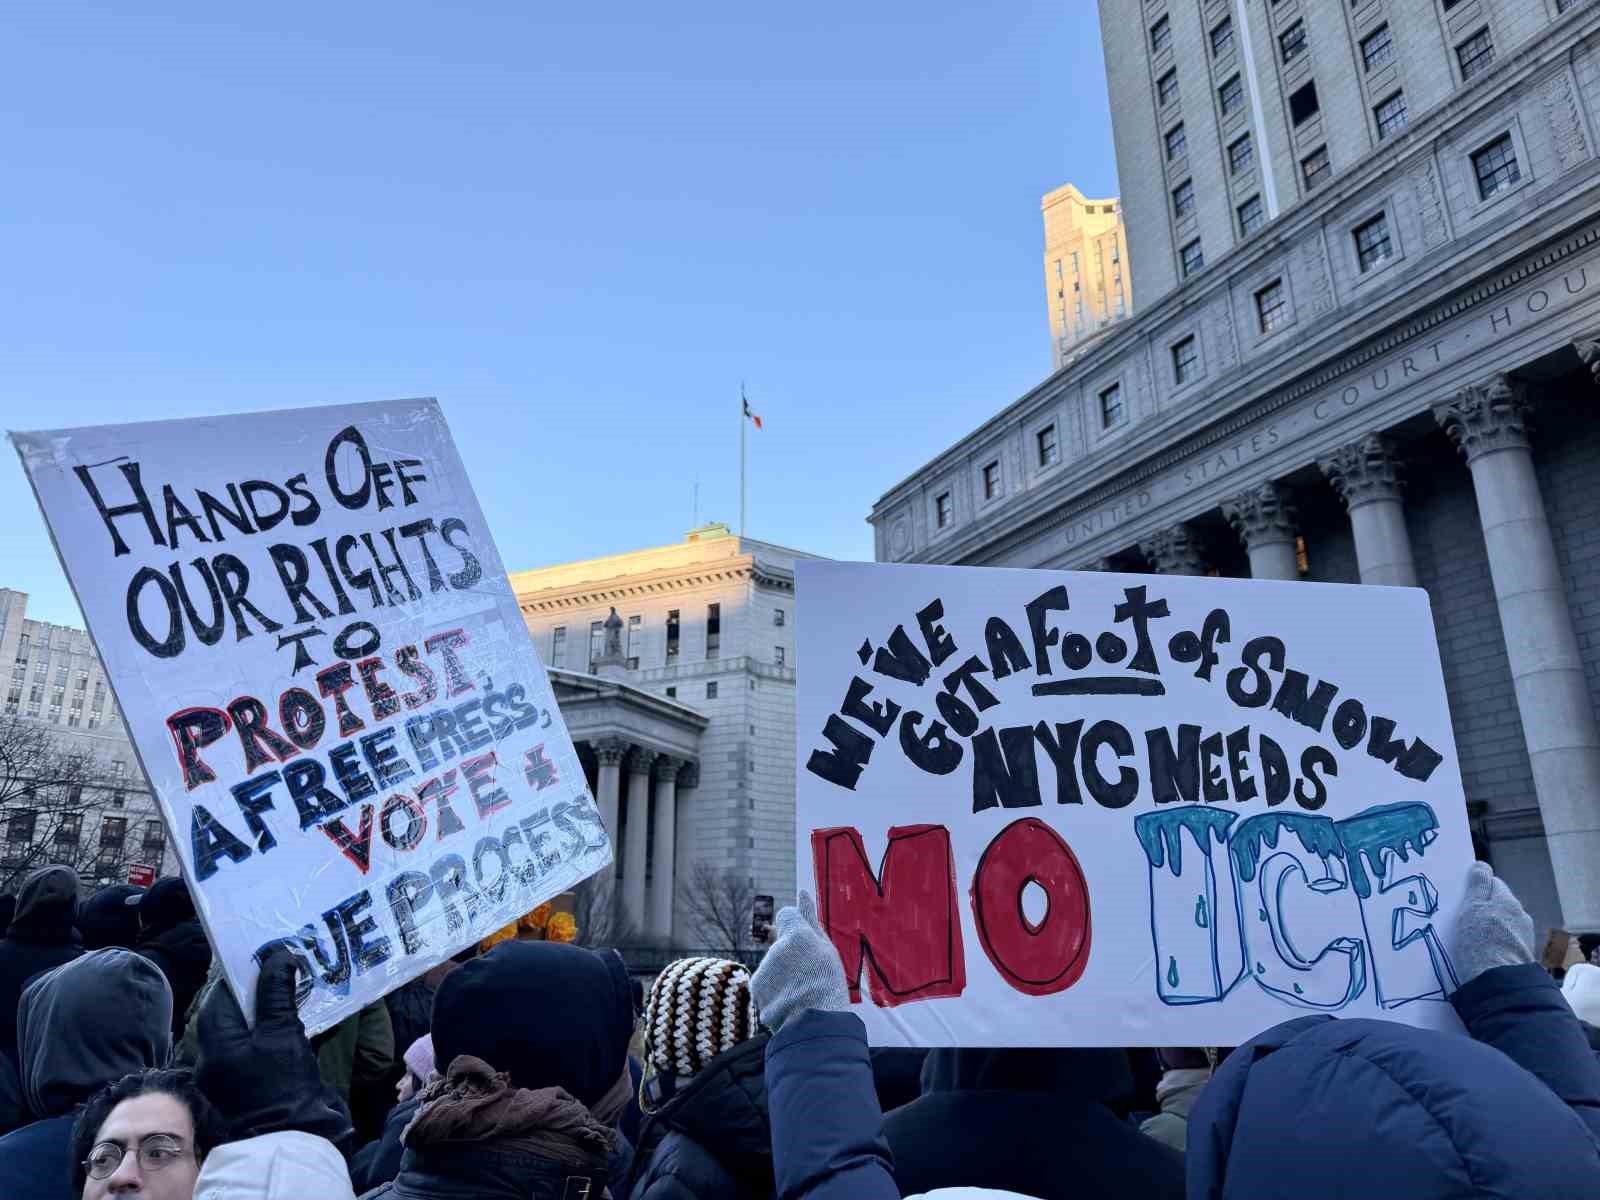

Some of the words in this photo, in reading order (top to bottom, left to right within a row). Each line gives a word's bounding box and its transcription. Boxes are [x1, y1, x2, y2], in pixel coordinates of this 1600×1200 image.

[1064, 491, 1151, 545] UNITED
[1183, 425, 1280, 487] STATES
[1313, 340, 1444, 420] COURT
[1489, 267, 1587, 334] HOU
[74, 456, 321, 557] HANDS
[325, 425, 427, 512] OFF
[126, 553, 283, 658] OUR
[268, 518, 483, 627] RIGHTS
[277, 620, 382, 677] TO
[806, 597, 959, 790] WE'VE
[899, 655, 1001, 775] GOT
[984, 615, 1032, 680] A
[1167, 607, 1231, 681] of
[1225, 635, 1444, 783] SNOW
[192, 803, 252, 882] A
[230, 726, 415, 854] FREE
[404, 682, 553, 776] PRESS,
[317, 751, 512, 874] VOTE
[971, 718, 1140, 814] NYC
[1144, 722, 1339, 810] NEEDS
[811, 816, 1092, 1008] NO
[1134, 801, 1460, 1010] ICE
